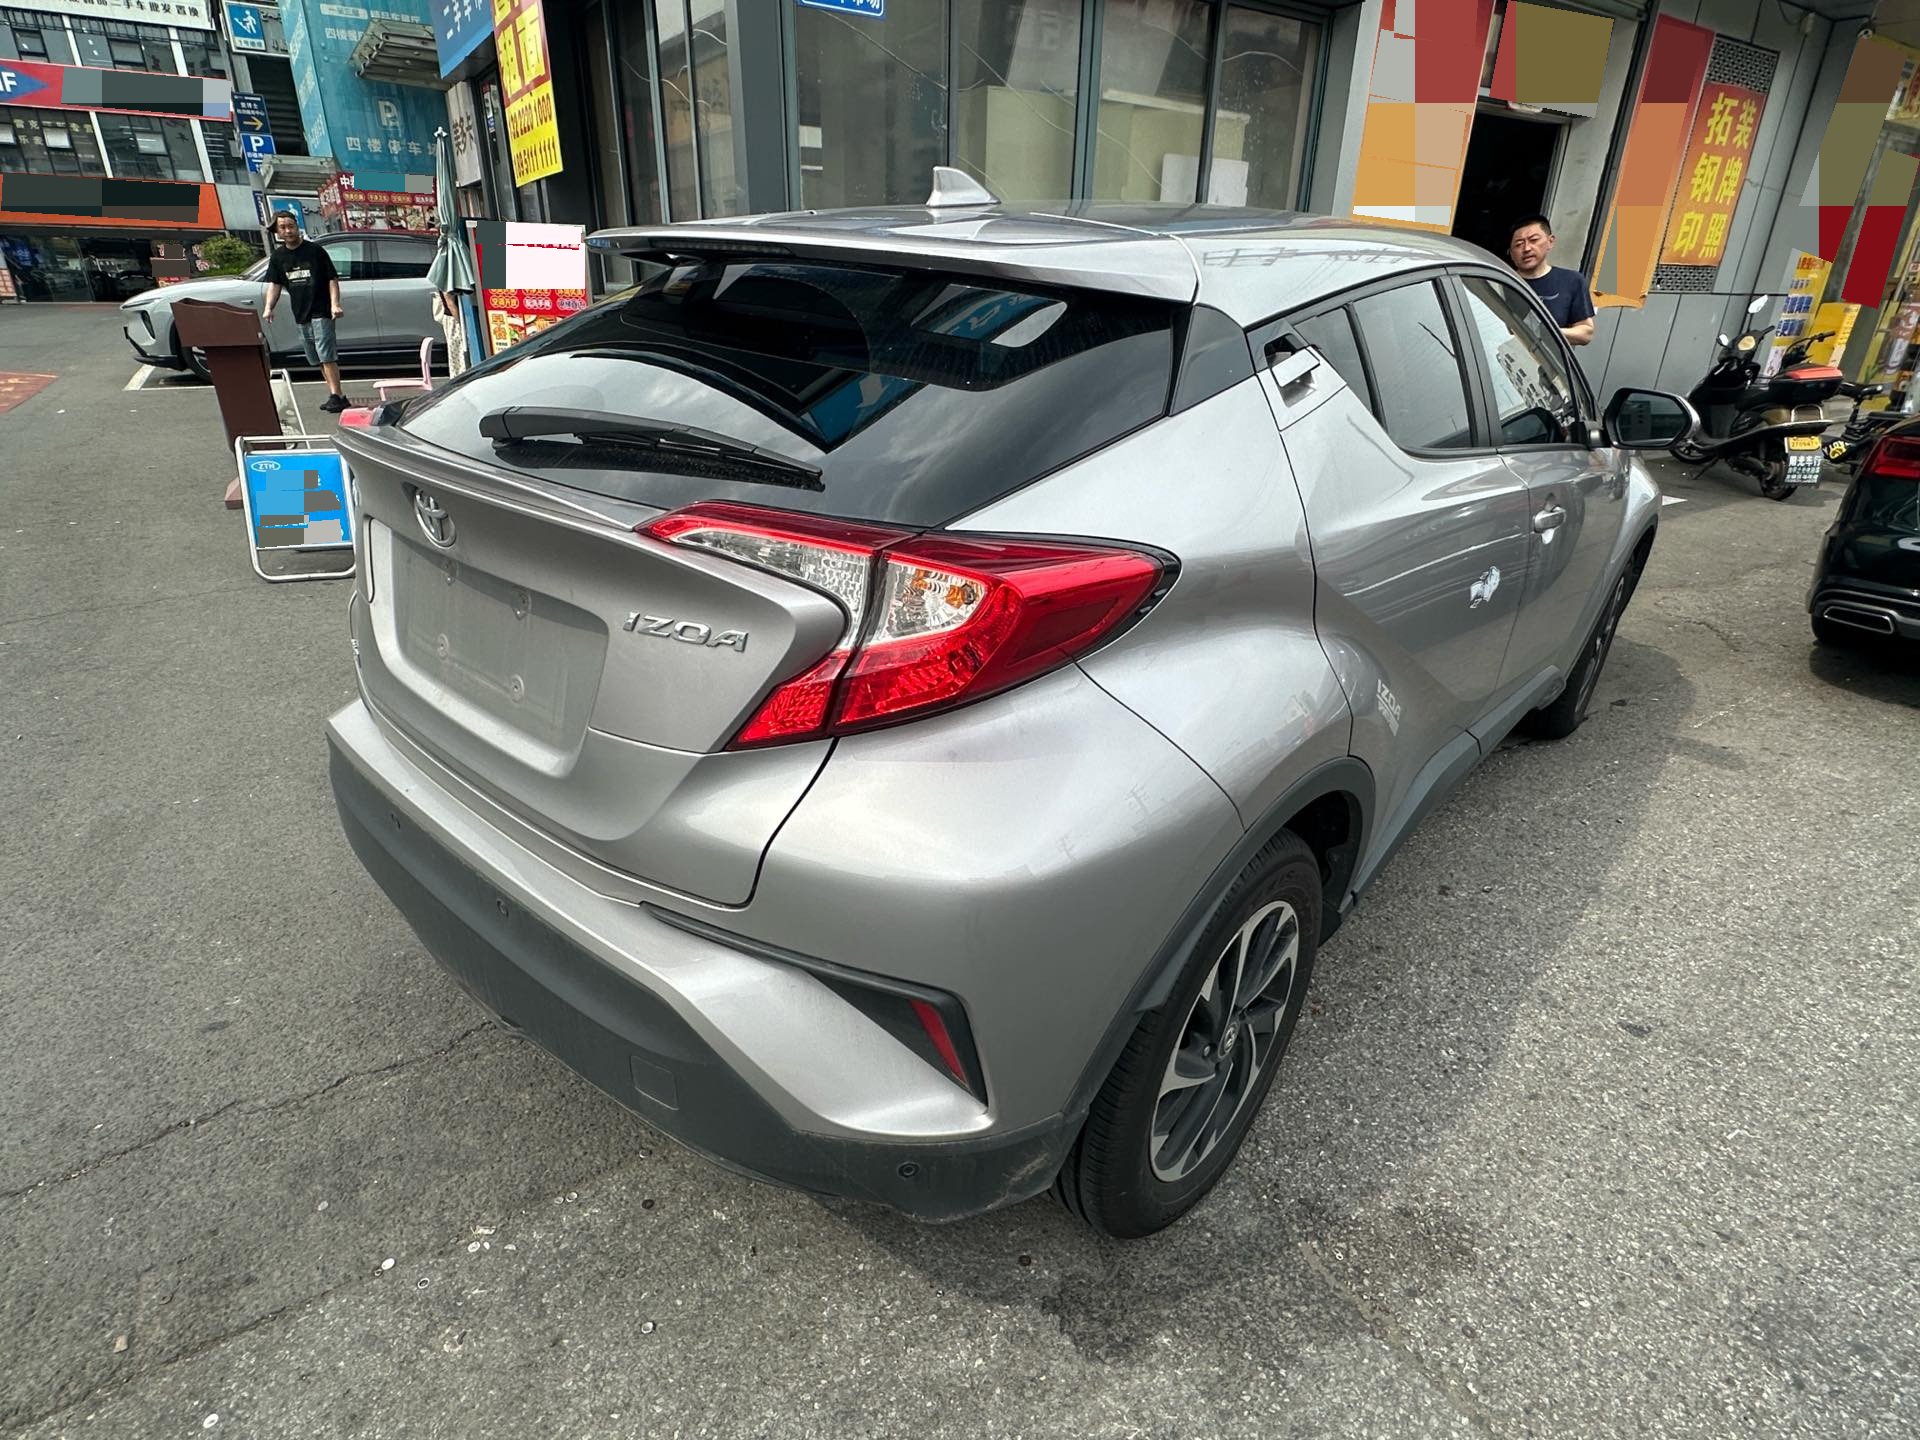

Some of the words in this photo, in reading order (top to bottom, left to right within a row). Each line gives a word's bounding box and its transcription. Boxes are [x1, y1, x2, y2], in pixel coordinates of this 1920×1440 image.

[378, 100, 400, 127] P
[250, 136, 264, 152] P
[622, 611, 749, 653] IZOA
